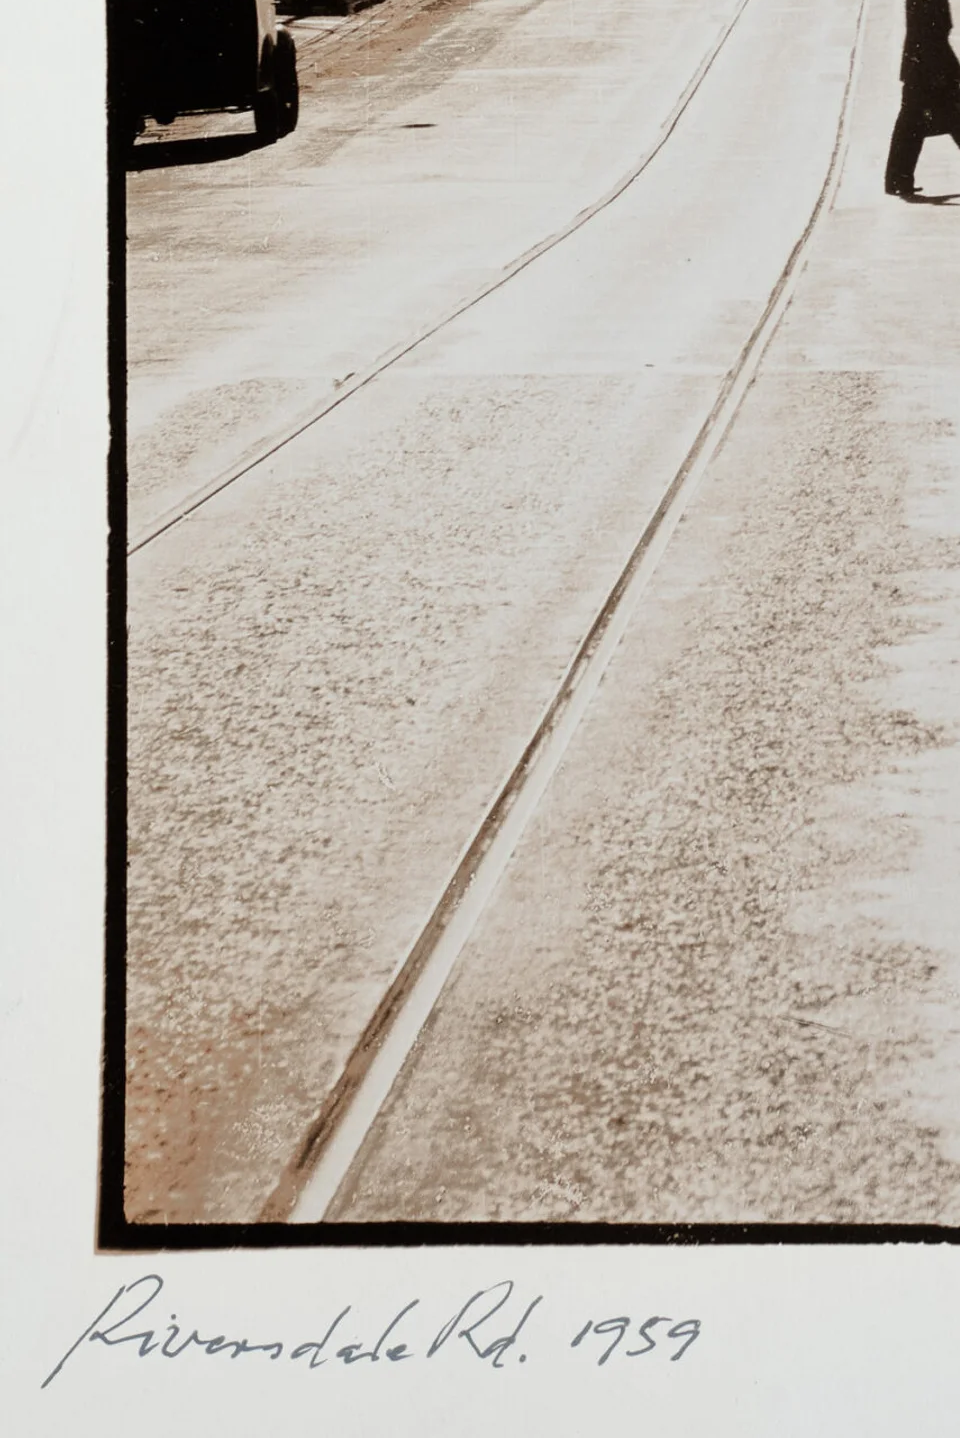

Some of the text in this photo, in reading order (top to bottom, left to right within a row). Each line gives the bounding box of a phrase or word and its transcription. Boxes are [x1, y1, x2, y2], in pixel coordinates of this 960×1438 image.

[41, 1274, 702, 1388] Riversdale Rd. 1959
